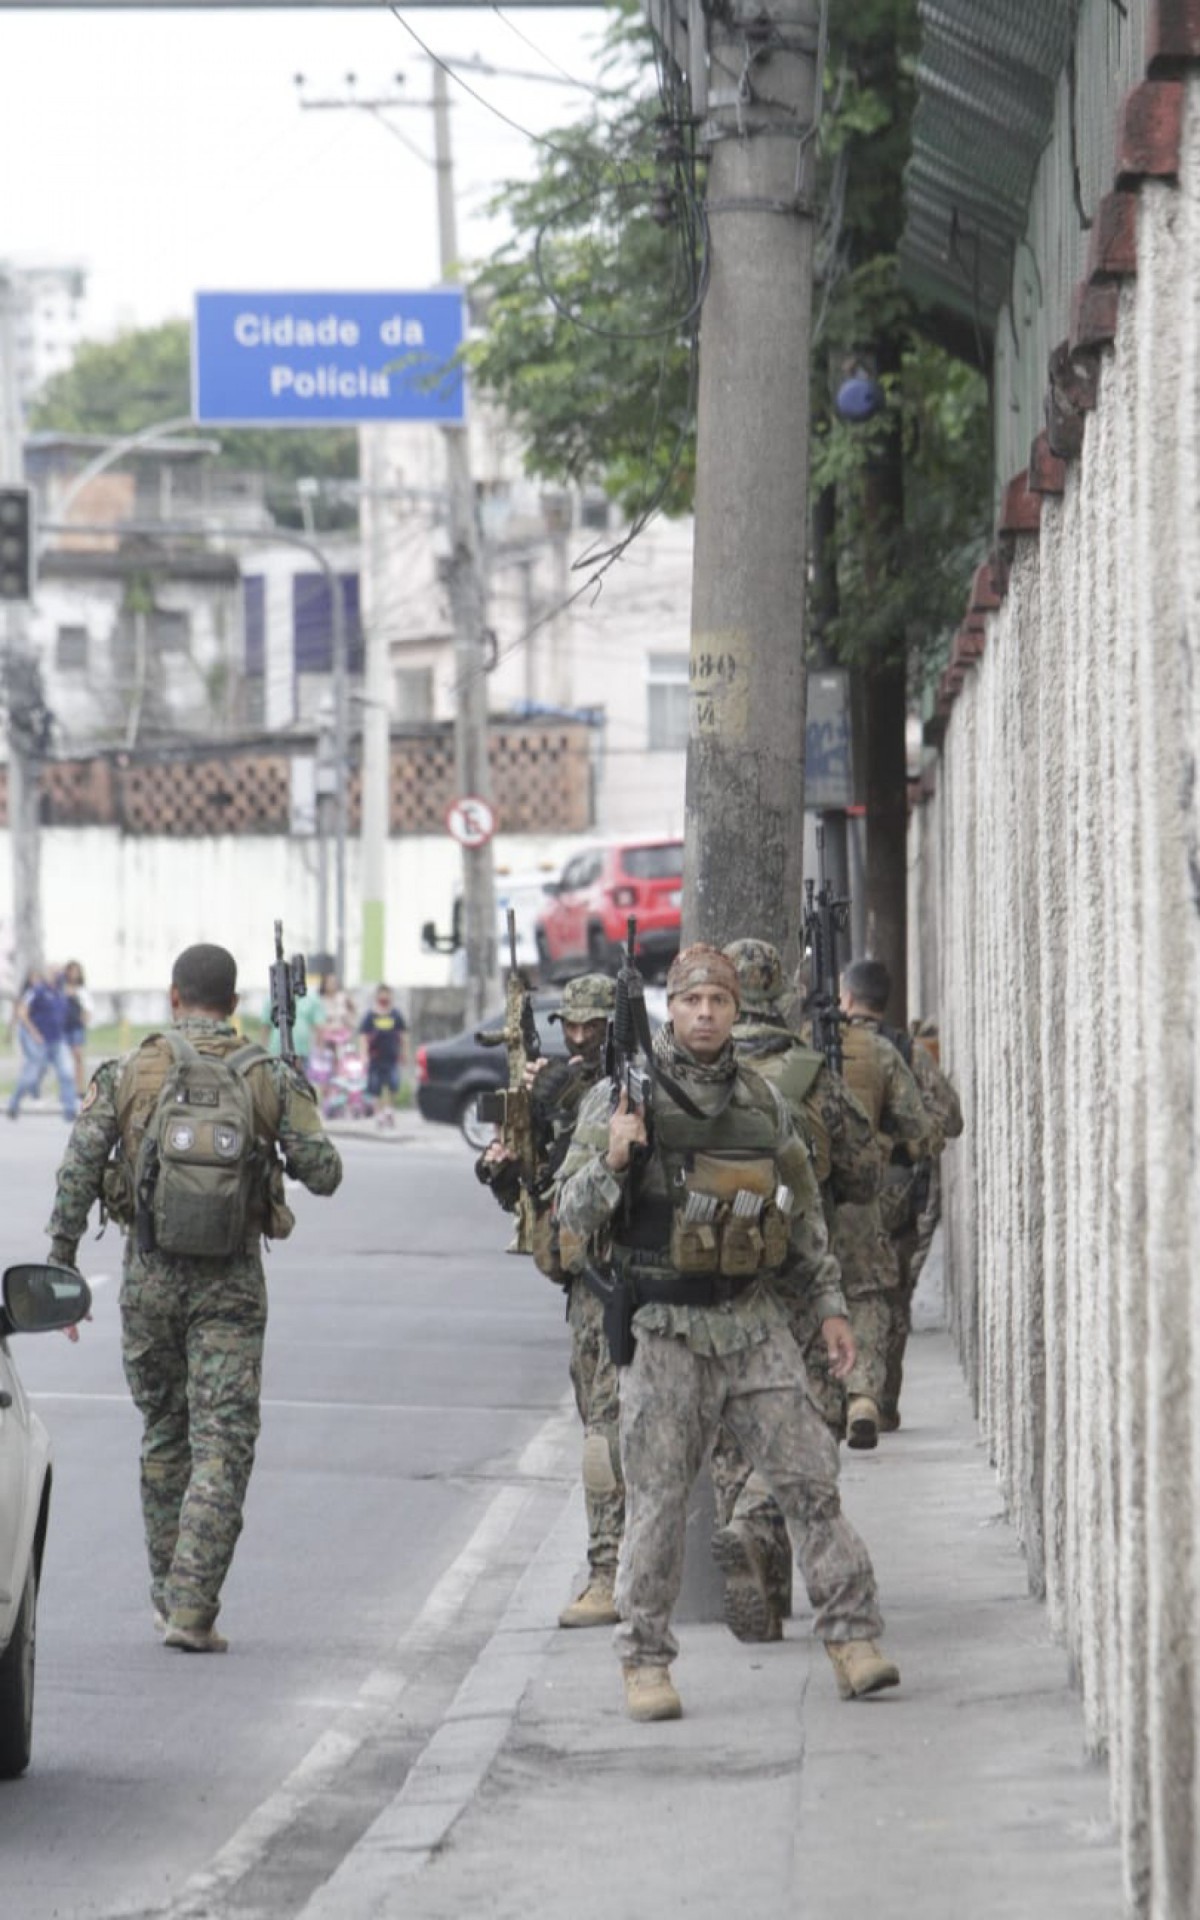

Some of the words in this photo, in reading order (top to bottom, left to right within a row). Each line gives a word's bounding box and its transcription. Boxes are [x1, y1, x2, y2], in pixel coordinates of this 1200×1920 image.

[234, 313, 360, 347] Cidade
[380, 315, 424, 346] da
[270, 363, 390, 397] Polícia
